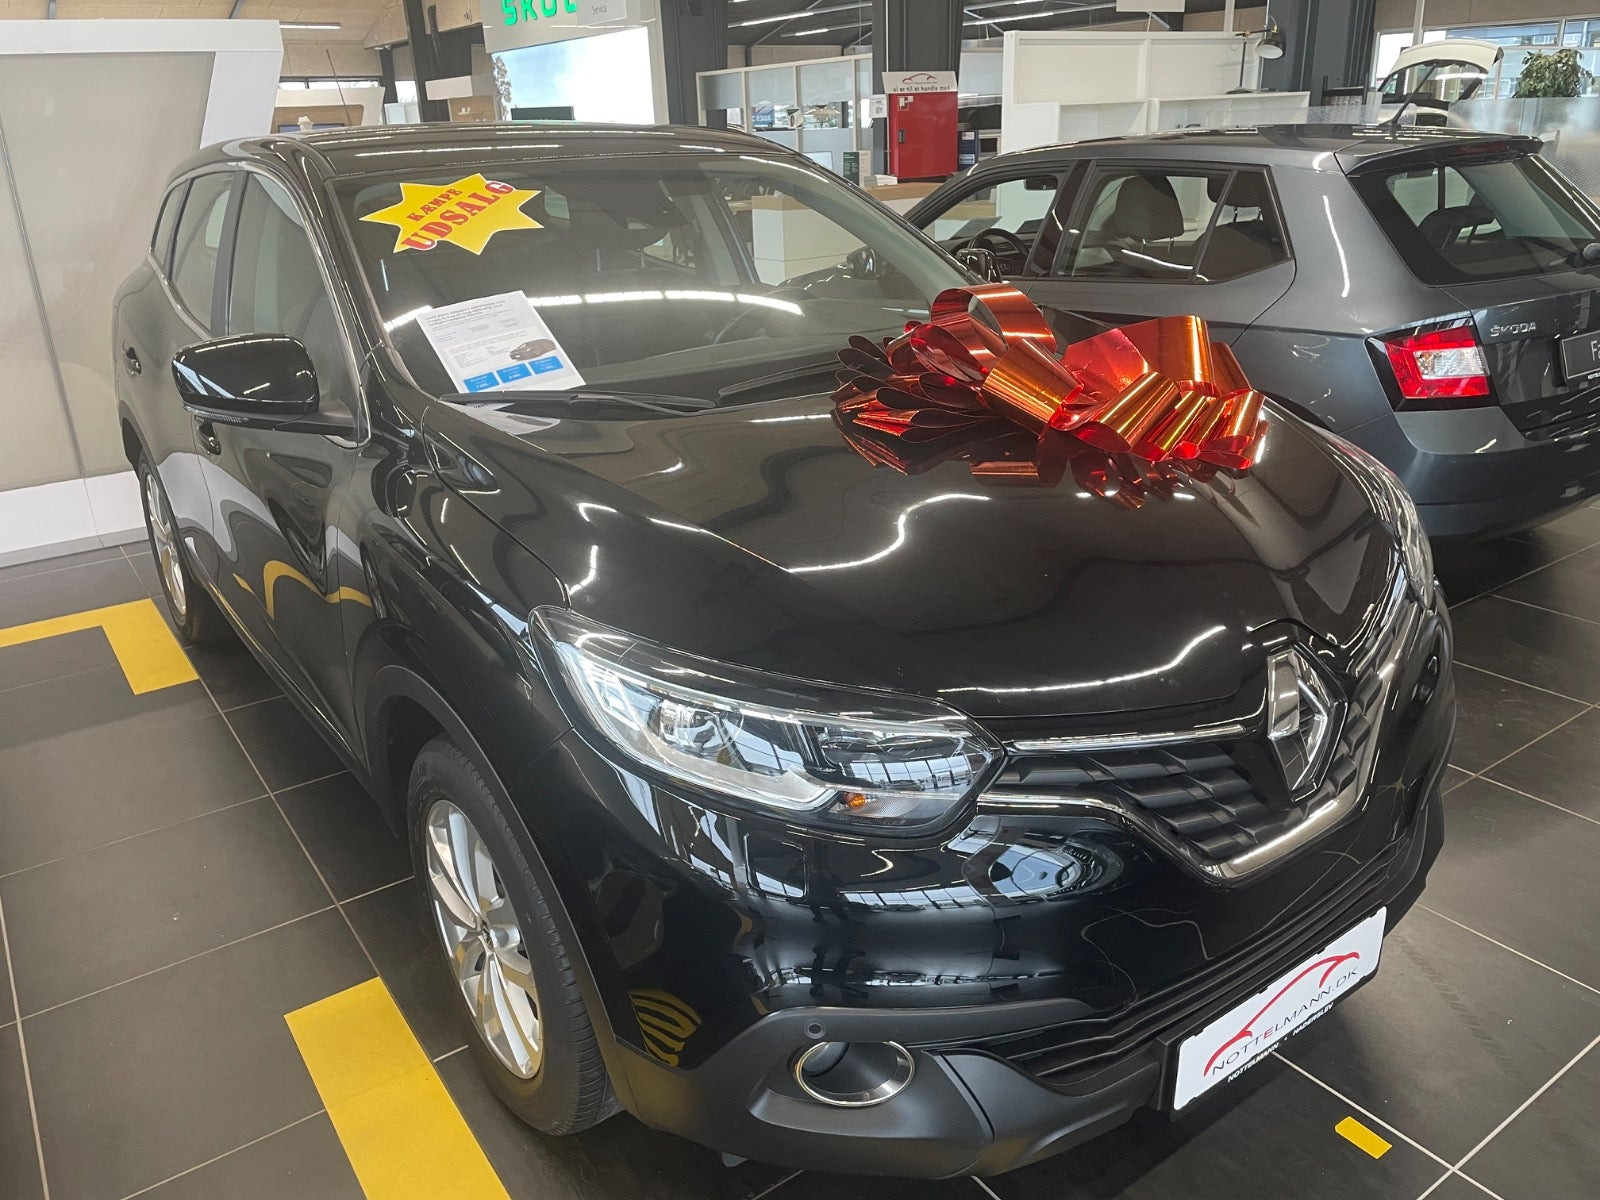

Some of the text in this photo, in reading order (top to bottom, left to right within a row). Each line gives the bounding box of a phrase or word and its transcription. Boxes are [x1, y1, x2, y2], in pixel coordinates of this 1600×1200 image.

[401, 181, 514, 250] UDSALG
[405, 188, 463, 222] KÆMPE
[1211, 966, 1358, 1076] NOTTELMANN.DK
[1227, 1002, 1335, 1083] NOTTELMANN HADERSLEV
